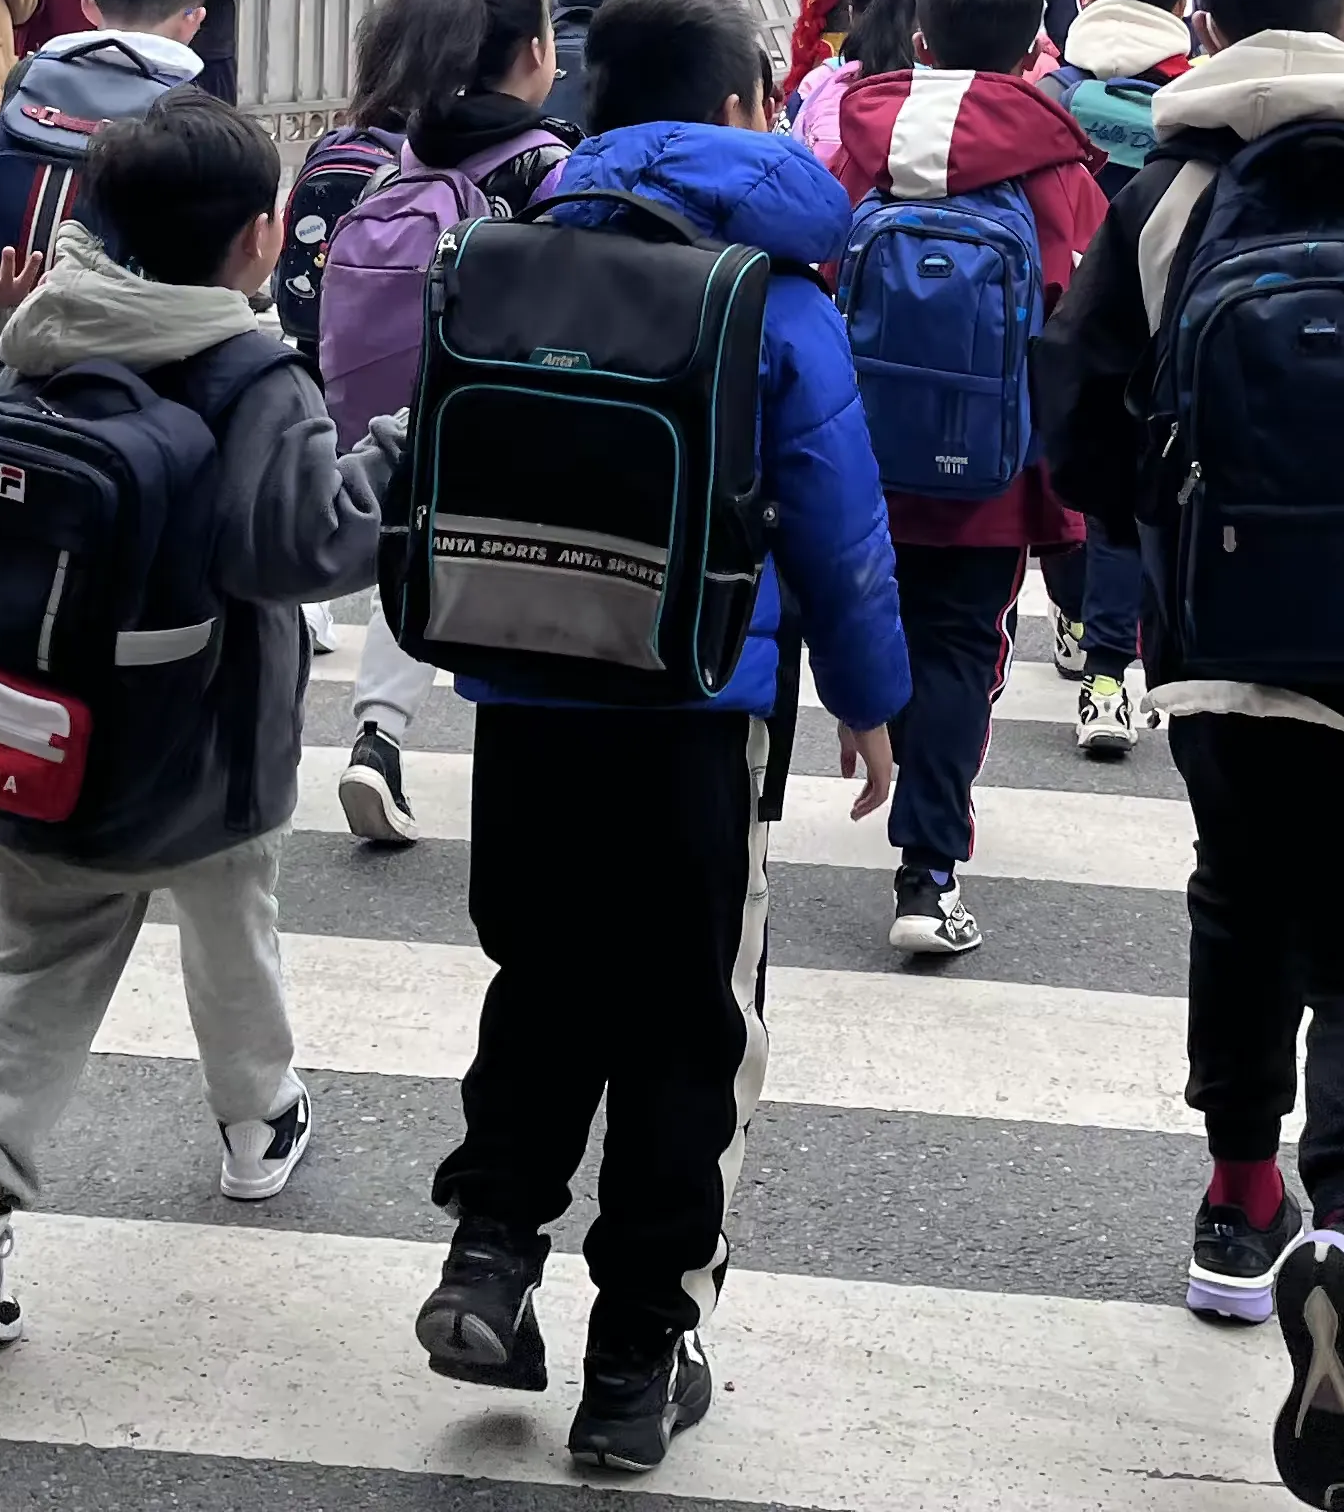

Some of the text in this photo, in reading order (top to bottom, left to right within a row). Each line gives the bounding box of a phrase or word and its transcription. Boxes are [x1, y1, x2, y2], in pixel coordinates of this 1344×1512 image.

[433, 536, 666, 585] ANTA SPORTS ANTA SPORTS
